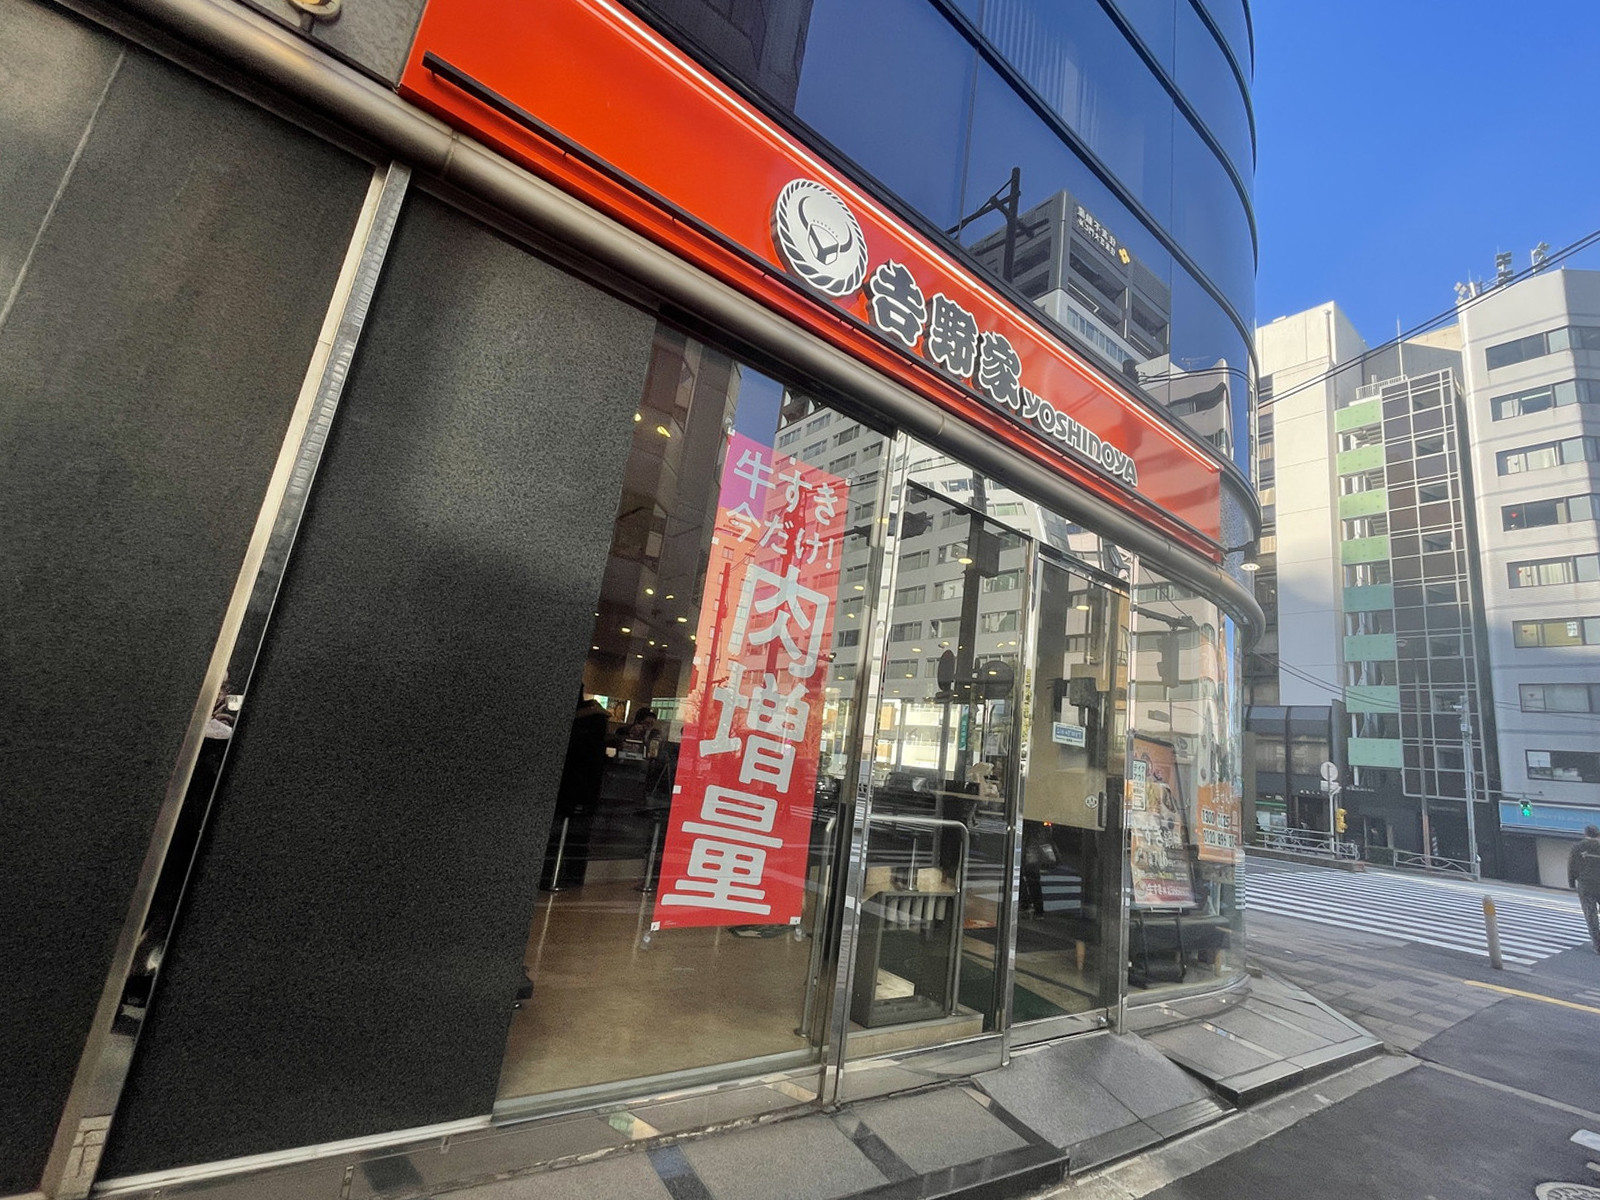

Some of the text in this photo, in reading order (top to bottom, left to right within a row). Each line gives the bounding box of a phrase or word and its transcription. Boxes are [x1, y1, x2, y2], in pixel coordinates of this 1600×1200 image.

[869, 259, 1023, 412] 吉野家
[733, 449, 839, 526] 牛すき
[1021, 386, 1138, 488] YOSHINOYA
[660, 563, 831, 916] 肉増量
